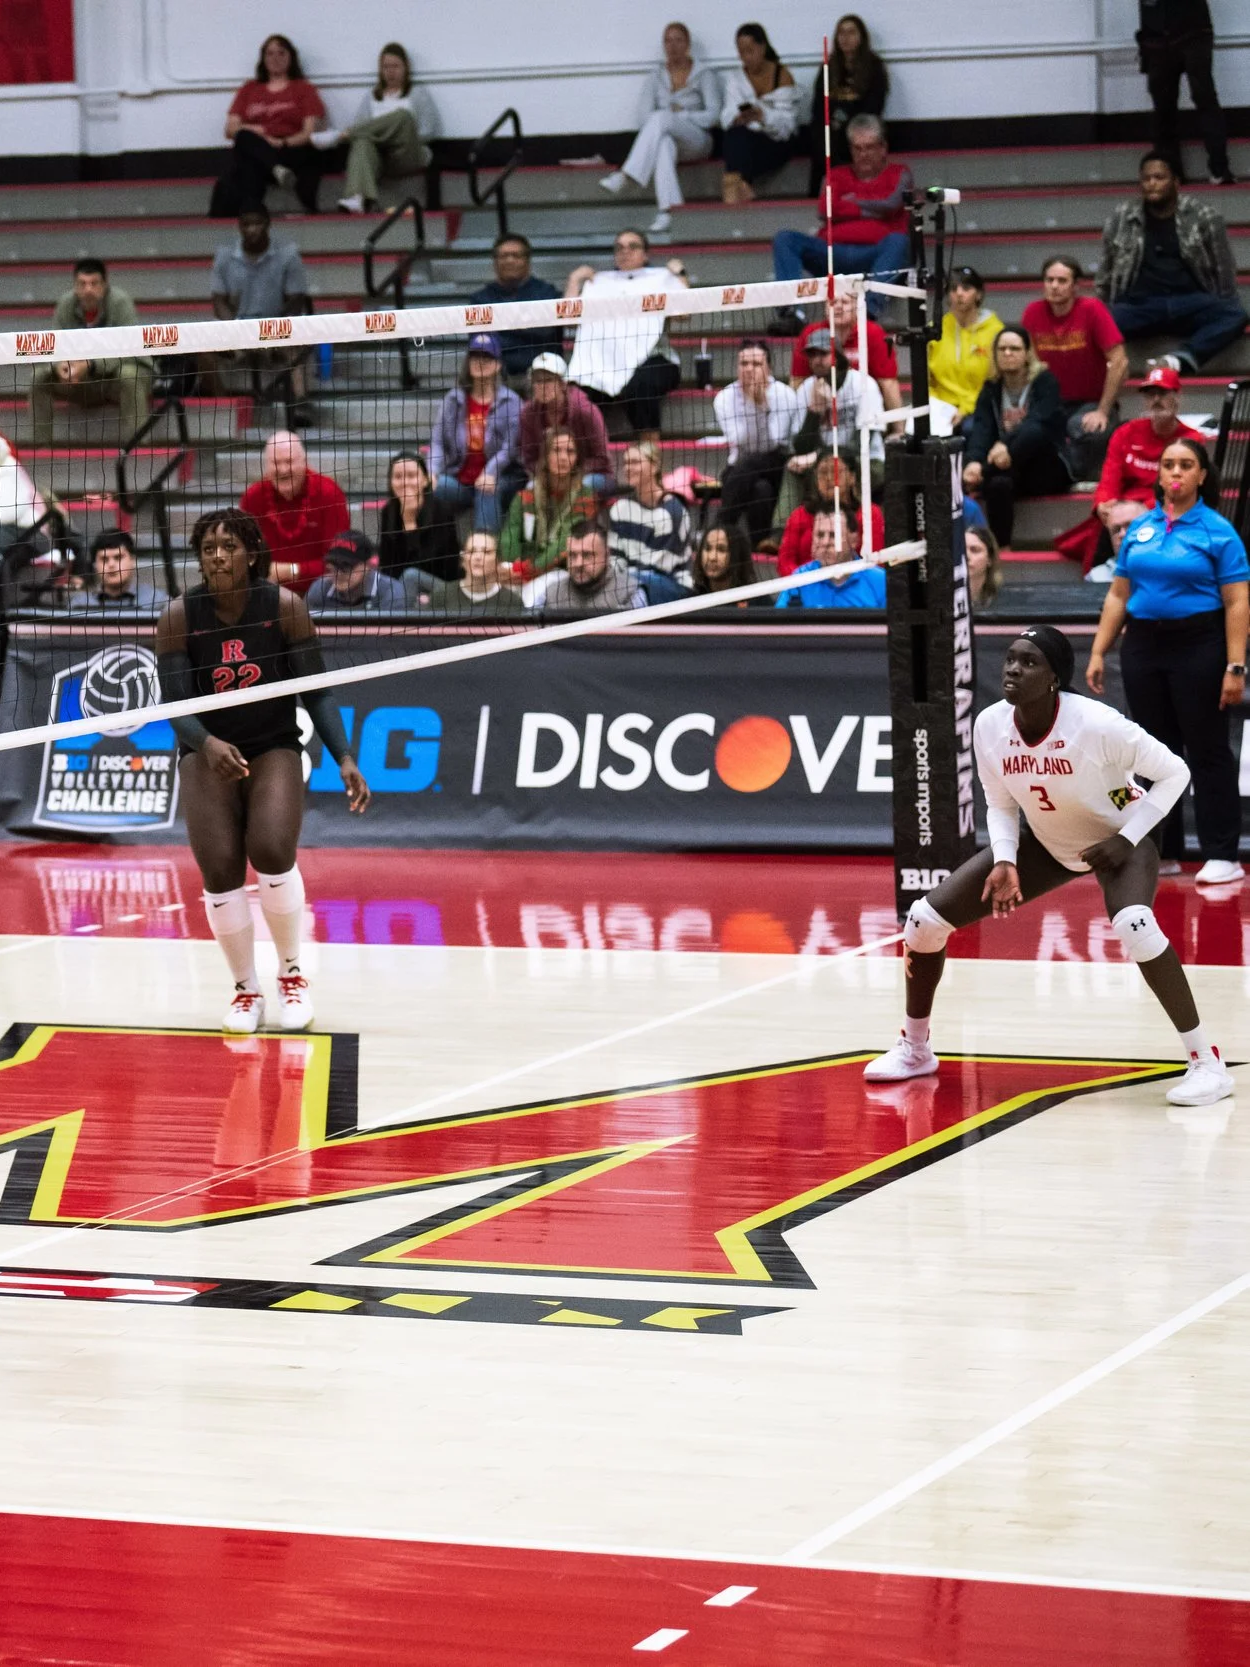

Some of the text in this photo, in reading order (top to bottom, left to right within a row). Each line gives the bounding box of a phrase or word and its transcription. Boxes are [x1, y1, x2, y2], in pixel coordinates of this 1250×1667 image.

[16, 332, 56, 352] MARYLAND
[143, 325, 179, 344] MARYLAND
[222, 639, 247, 664] R
[212, 663, 262, 694] 22
[952, 553, 977, 838] TERRAPINS
[516, 711, 894, 794] DISCOVE
[1002, 755, 1073, 776] MARYLAND
[51, 772, 169, 790] VOLLEYBALL
[913, 729, 933, 846] sports imports
[46, 790, 169, 813] CHALLENGE
[1030, 785, 1056, 811] 3
